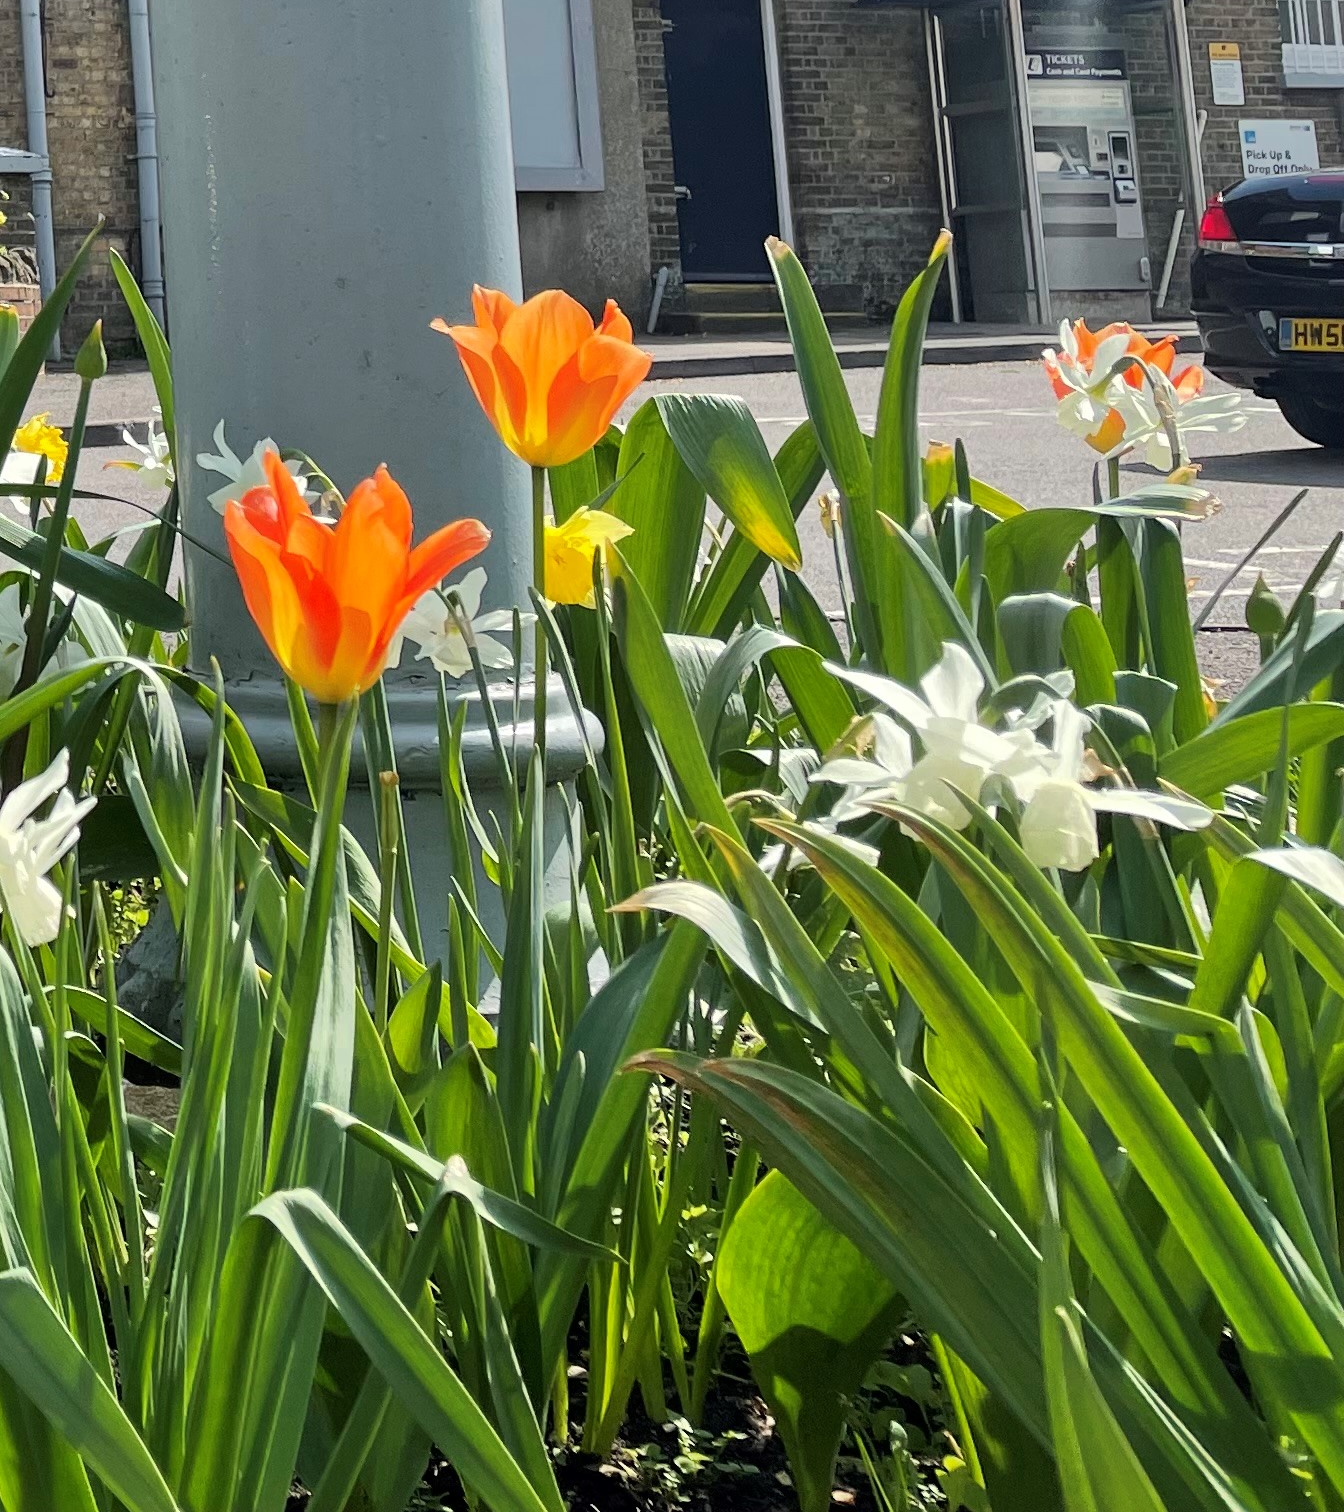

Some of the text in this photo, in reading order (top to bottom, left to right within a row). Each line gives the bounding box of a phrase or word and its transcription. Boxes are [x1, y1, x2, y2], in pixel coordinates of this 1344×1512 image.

[1045, 54, 1085, 65] TICKETS
[1246, 149, 1292, 162] Pick Up &
[1248, 164, 1271, 175] Drop
[1273, 164, 1288, 175] Off
[1294, 323, 1344, 347] HW5
